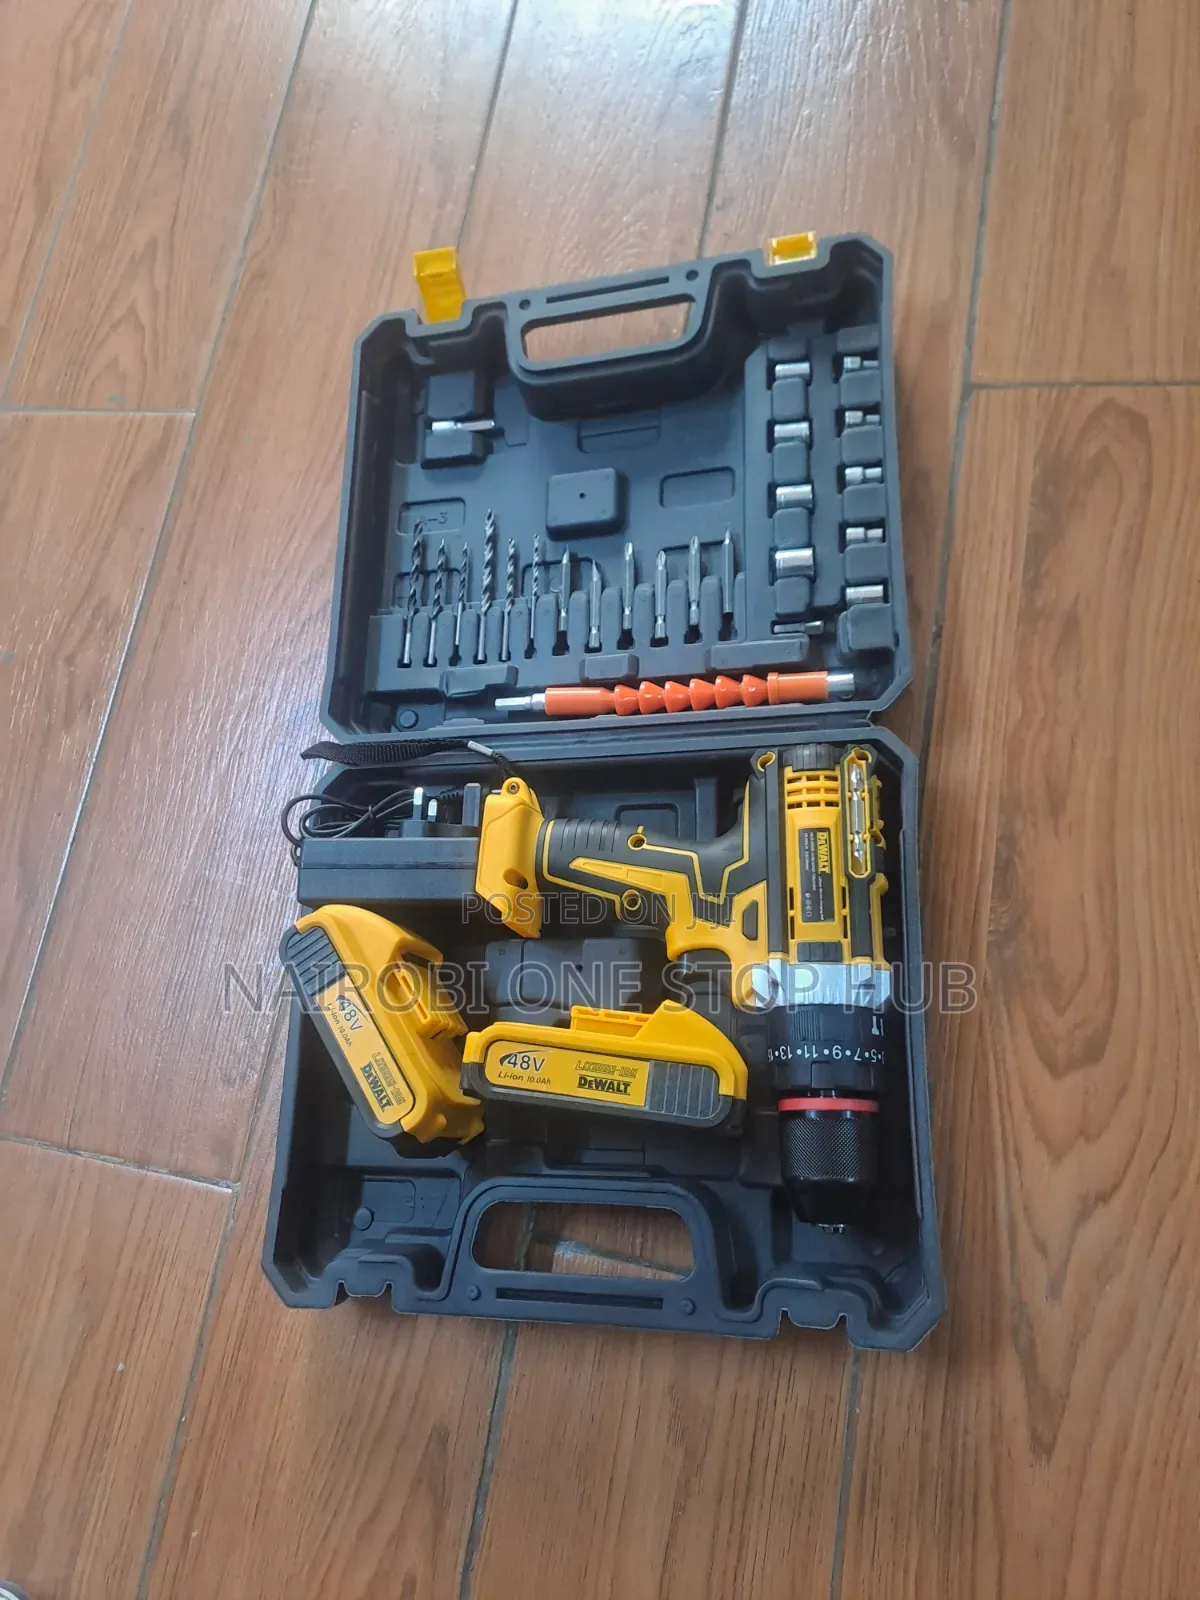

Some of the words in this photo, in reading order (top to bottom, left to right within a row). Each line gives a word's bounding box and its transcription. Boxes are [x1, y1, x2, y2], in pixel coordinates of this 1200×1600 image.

[817, 832, 830, 874] DEWALT
[339, 1000, 364, 1031] 48V
[779, 1045, 793, 1061] 13
[803, 1045, 819, 1059] 11
[832, 1045, 842, 1060] 9
[853, 1047, 862, 1061] 7
[870, 1049, 877, 1063] 5
[507, 1053, 546, 1072] 48V
[360, 1061, 393, 1113] DEWALT
[526, 1076, 552, 1085] 10.0Ah
[577, 1074, 632, 1096] DEWALT
